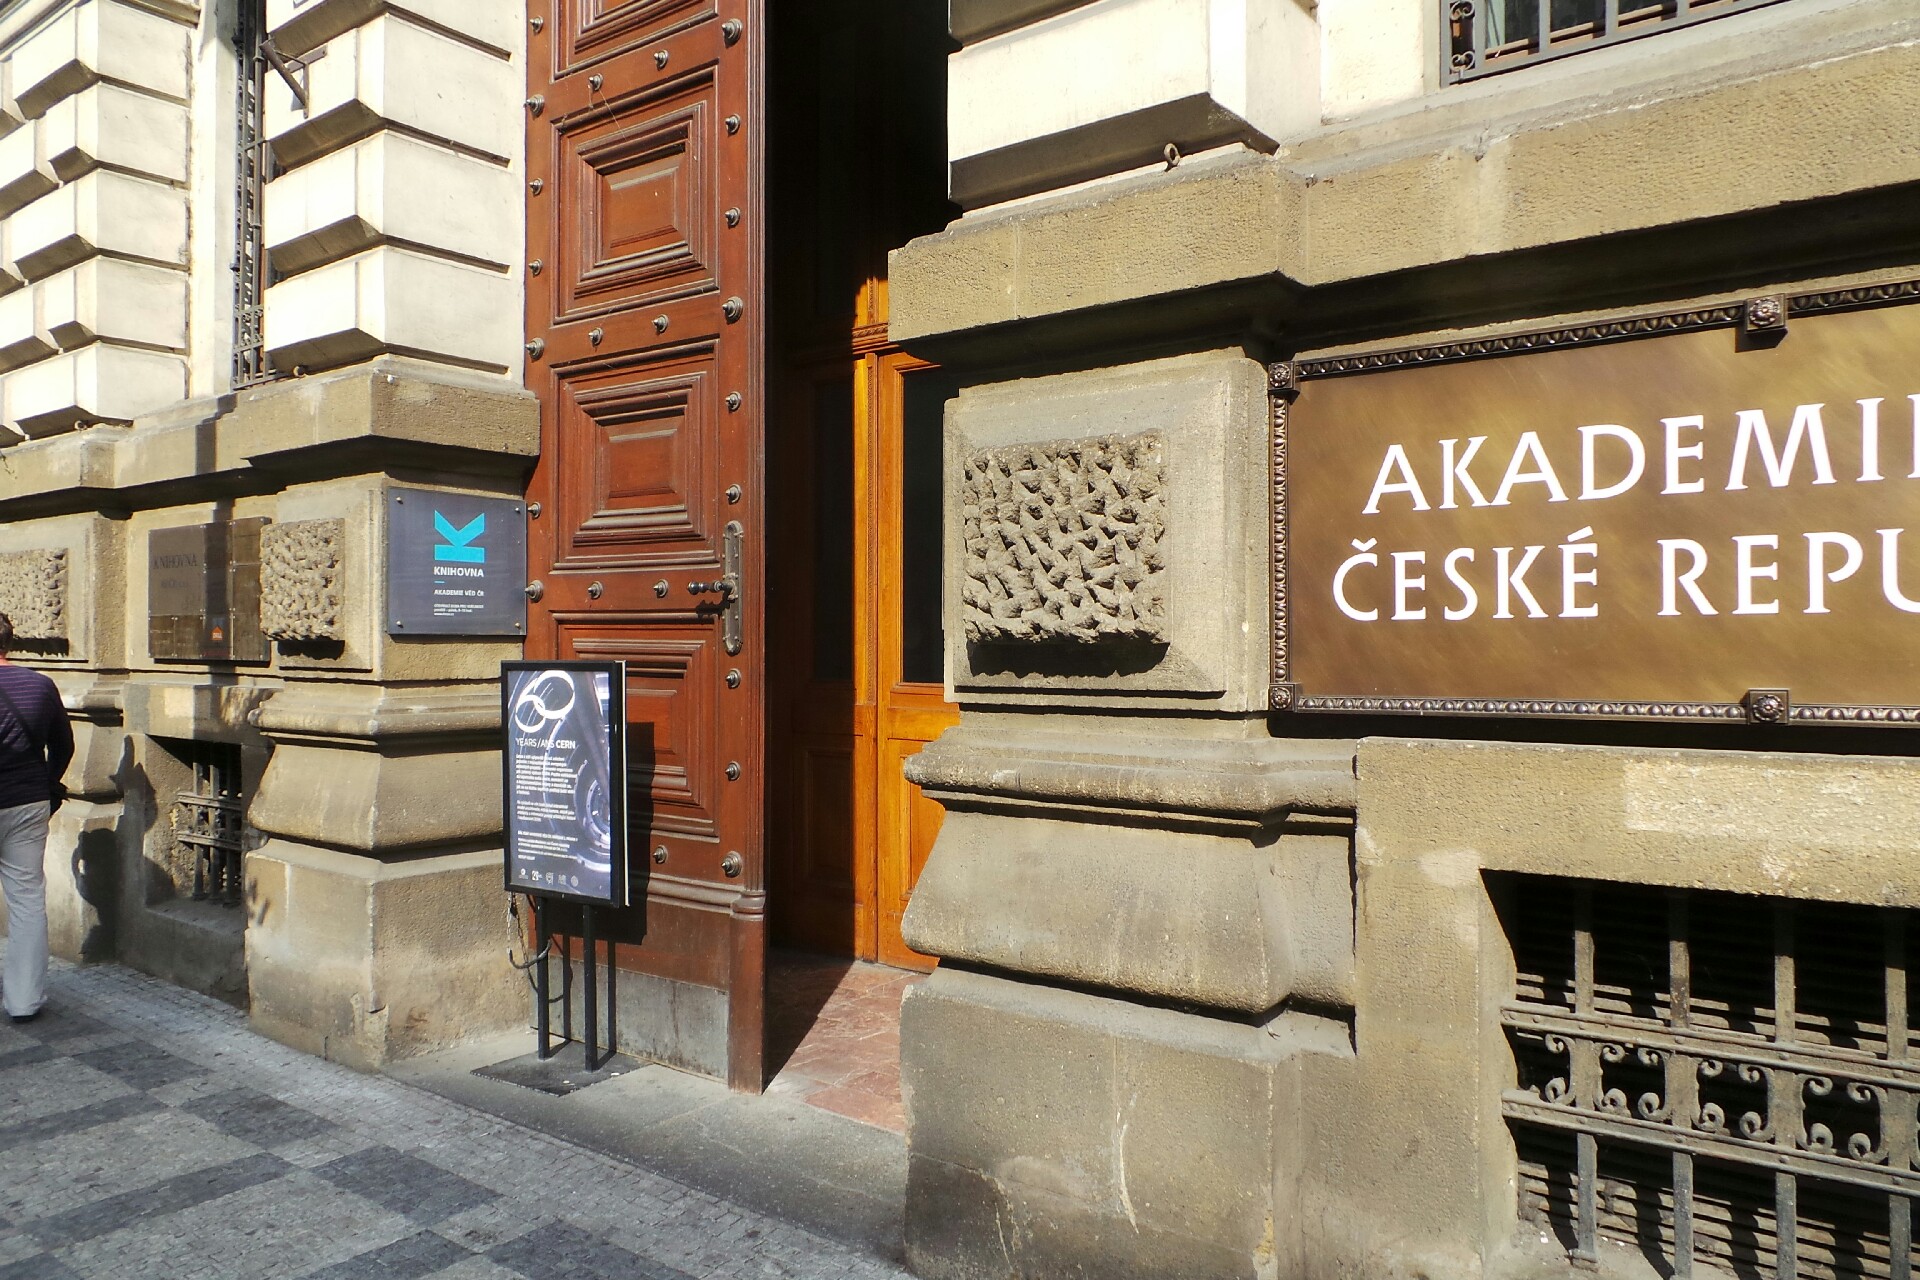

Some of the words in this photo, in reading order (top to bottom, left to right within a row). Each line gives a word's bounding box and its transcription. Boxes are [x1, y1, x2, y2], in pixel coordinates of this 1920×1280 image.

[433, 566, 484, 577] KNIHOVNA
[1331, 525, 1599, 622] ČESKÉ
[555, 739, 576, 749] CERN
